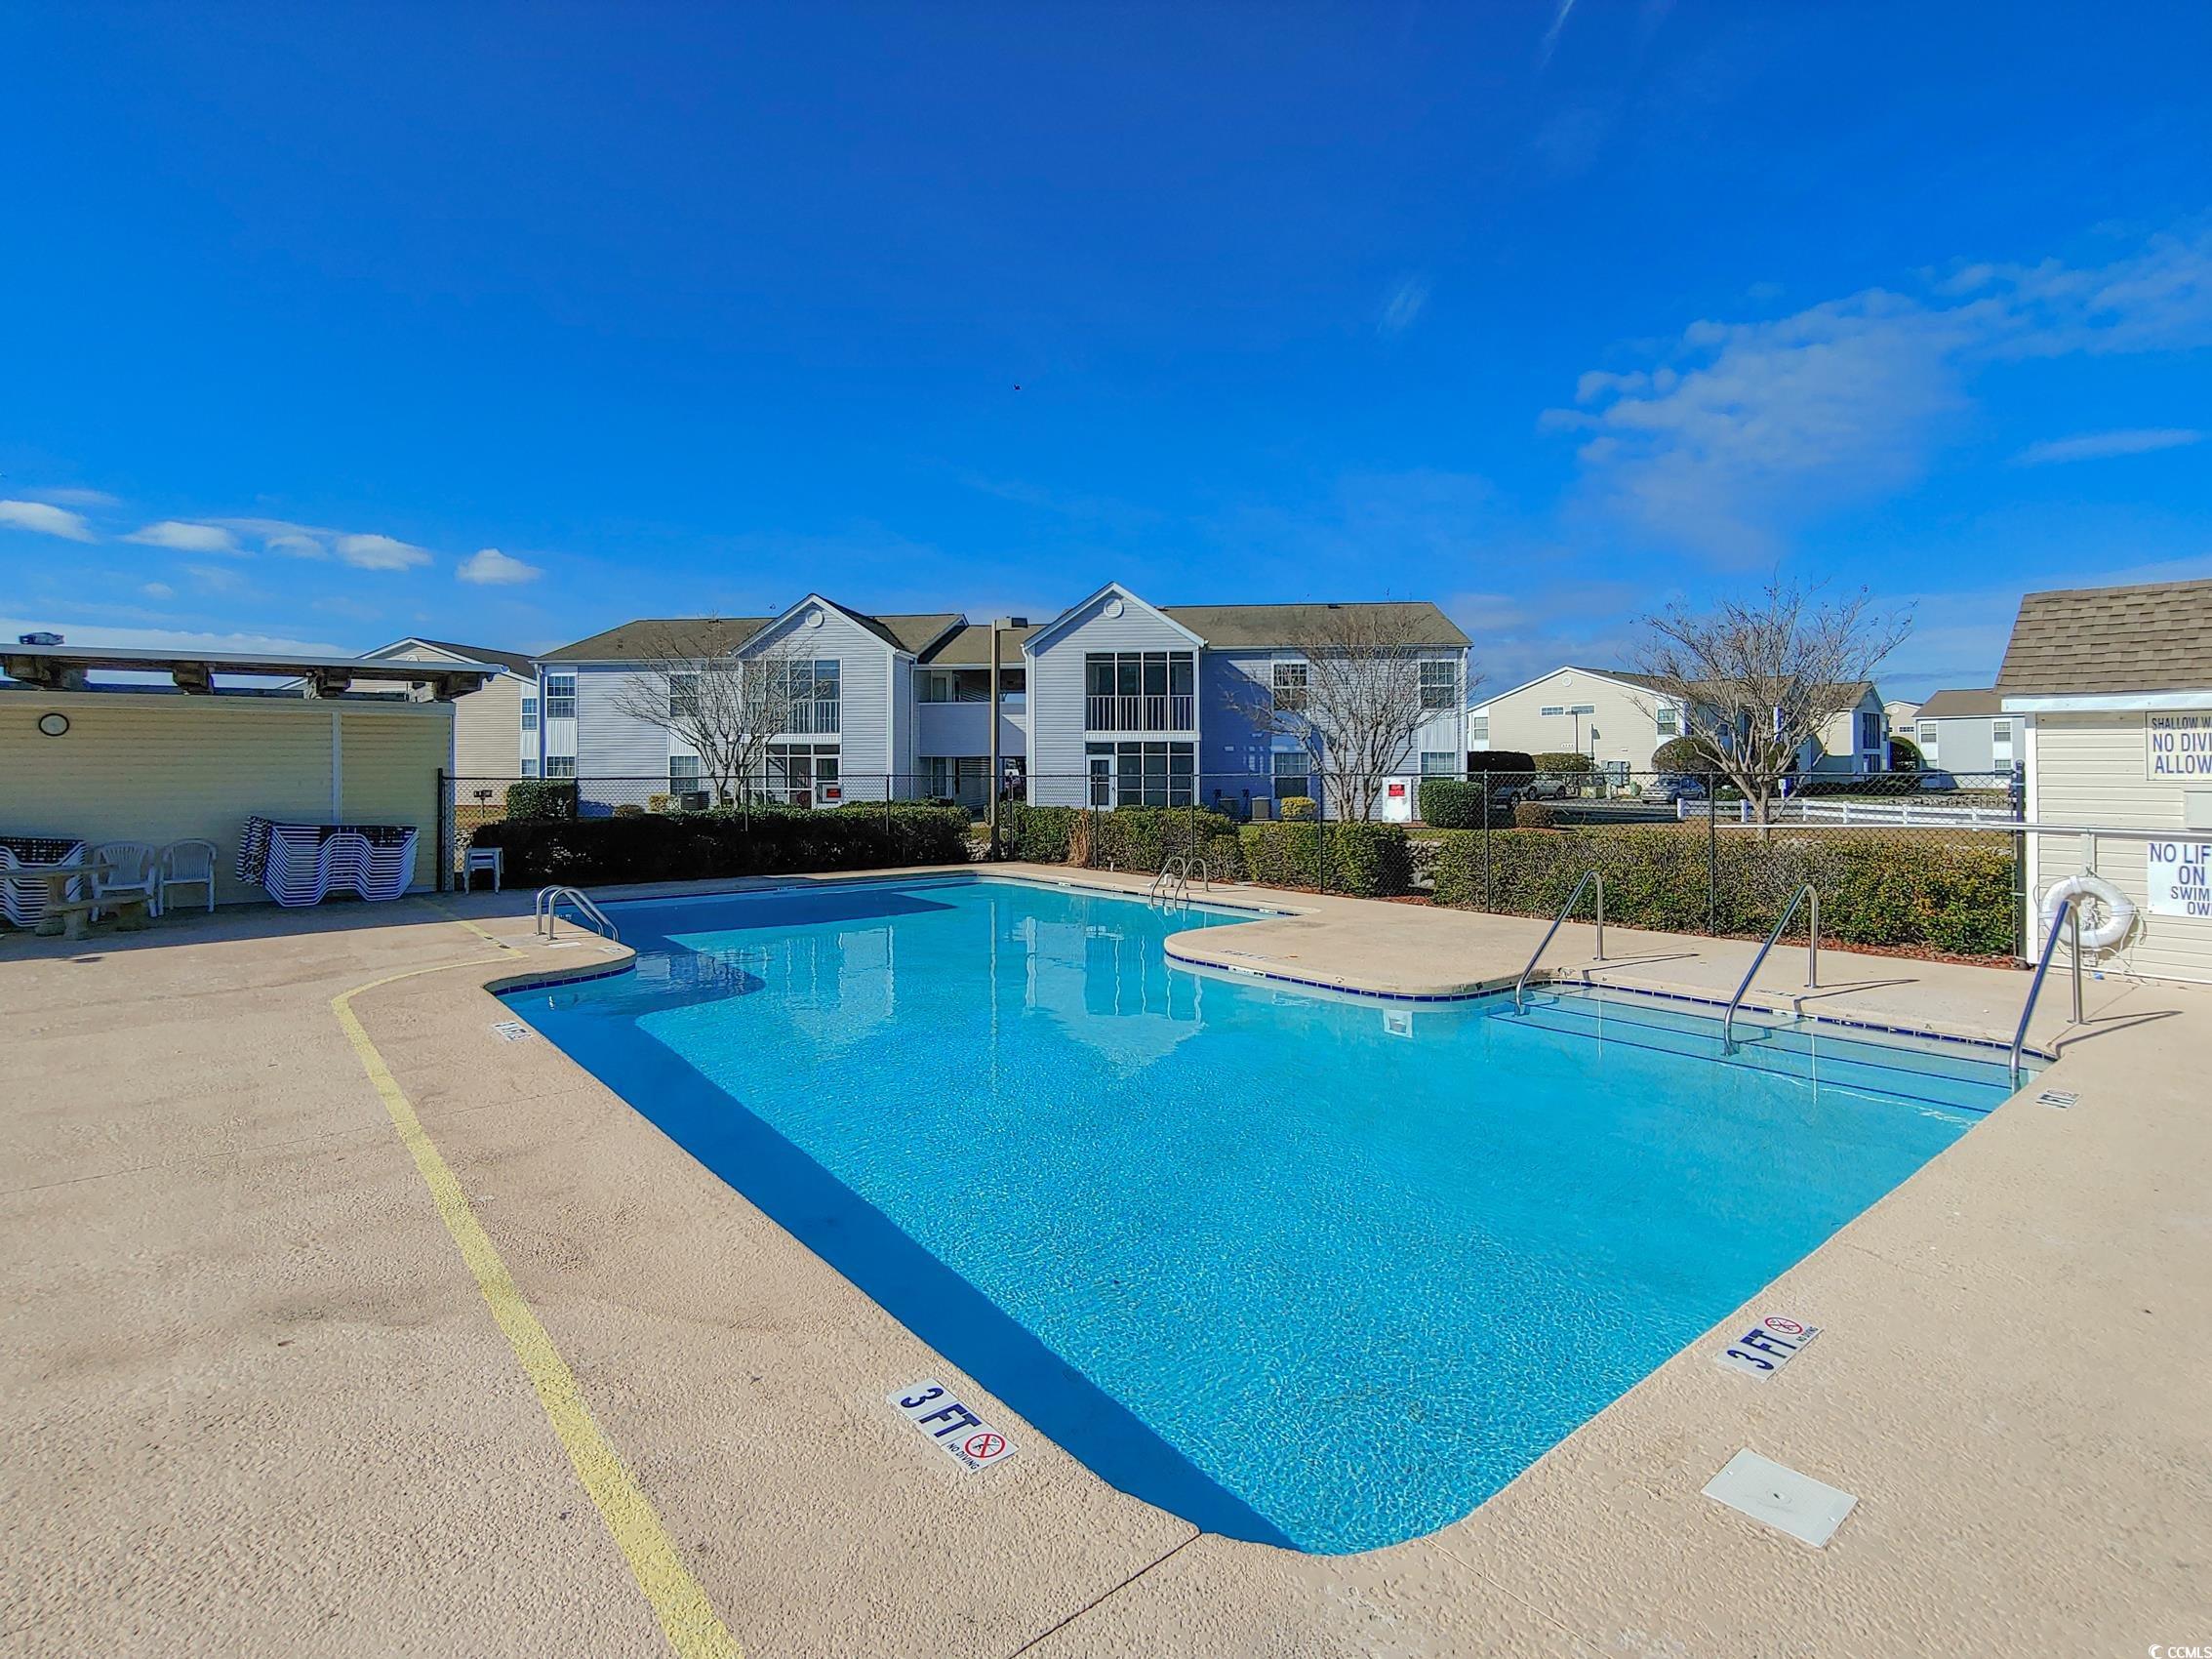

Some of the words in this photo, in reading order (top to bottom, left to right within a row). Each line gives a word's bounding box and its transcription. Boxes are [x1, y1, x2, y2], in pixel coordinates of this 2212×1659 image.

[2152, 716, 2198, 730] SHALLOW
[2152, 733, 2174, 752] NO
[2154, 754, 2212, 774] ALLOW
[2149, 843, 2177, 863] NO
[2184, 844, 2212, 865] LIF
[2179, 866, 2205, 886] ON
[2171, 886, 2210, 902] SWIM
[2188, 901, 2212, 915] OW
[1740, 1328, 1797, 1359] FT
[1726, 1350, 1775, 1370] 3
[900, 1387, 945, 1408] 3
[918, 1403, 983, 1438] FT
[946, 1442, 960, 1453] NO
[956, 1449, 981, 1470] DIVING
